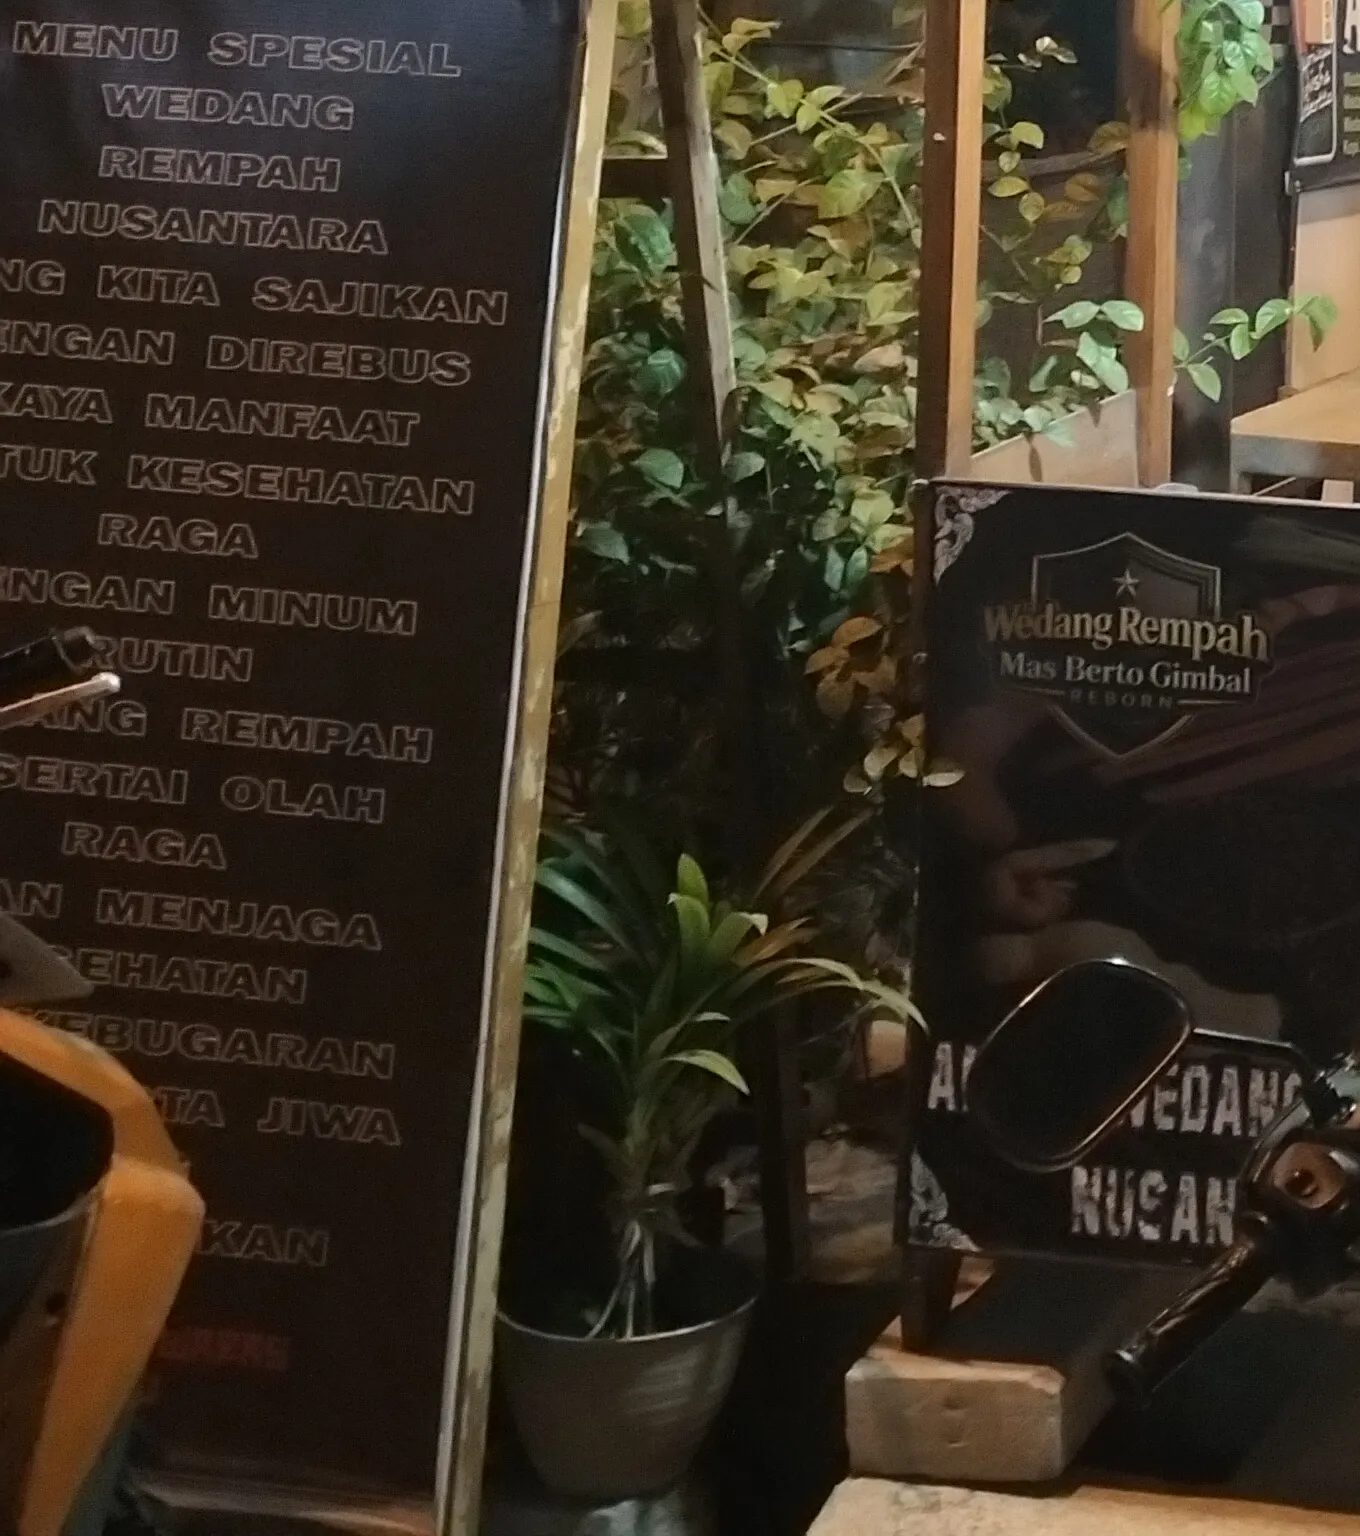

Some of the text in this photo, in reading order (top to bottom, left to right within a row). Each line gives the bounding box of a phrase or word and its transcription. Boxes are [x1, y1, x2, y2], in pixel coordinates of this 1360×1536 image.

[13, 21, 462, 77] MENU SPESIAL
[101, 83, 354, 130] WEDANG
[99, 145, 341, 192] REMPAH
[38, 199, 388, 255] NUSANTARA
[97, 265, 220, 306] KITA
[252, 276, 508, 326] SAJIKAN
[207, 335, 471, 386] DIREBUS
[145, 393, 420, 447] MANFAAT
[127, 454, 475, 516] KESEHATAN
[99, 512, 258, 559] RAGA
[208, 584, 418, 636] MINUM
[984, 604, 1269, 661] Wedang Rempah
[1000, 651, 1251, 693] Mas Berto Gimbal
[181, 707, 433, 764] REMPAH
[220, 775, 386, 825] OLAH
[62, 821, 227, 870] RAGA
[99, 887, 382, 951] MENJAGA
[257, 1096, 402, 1147] JIWA
